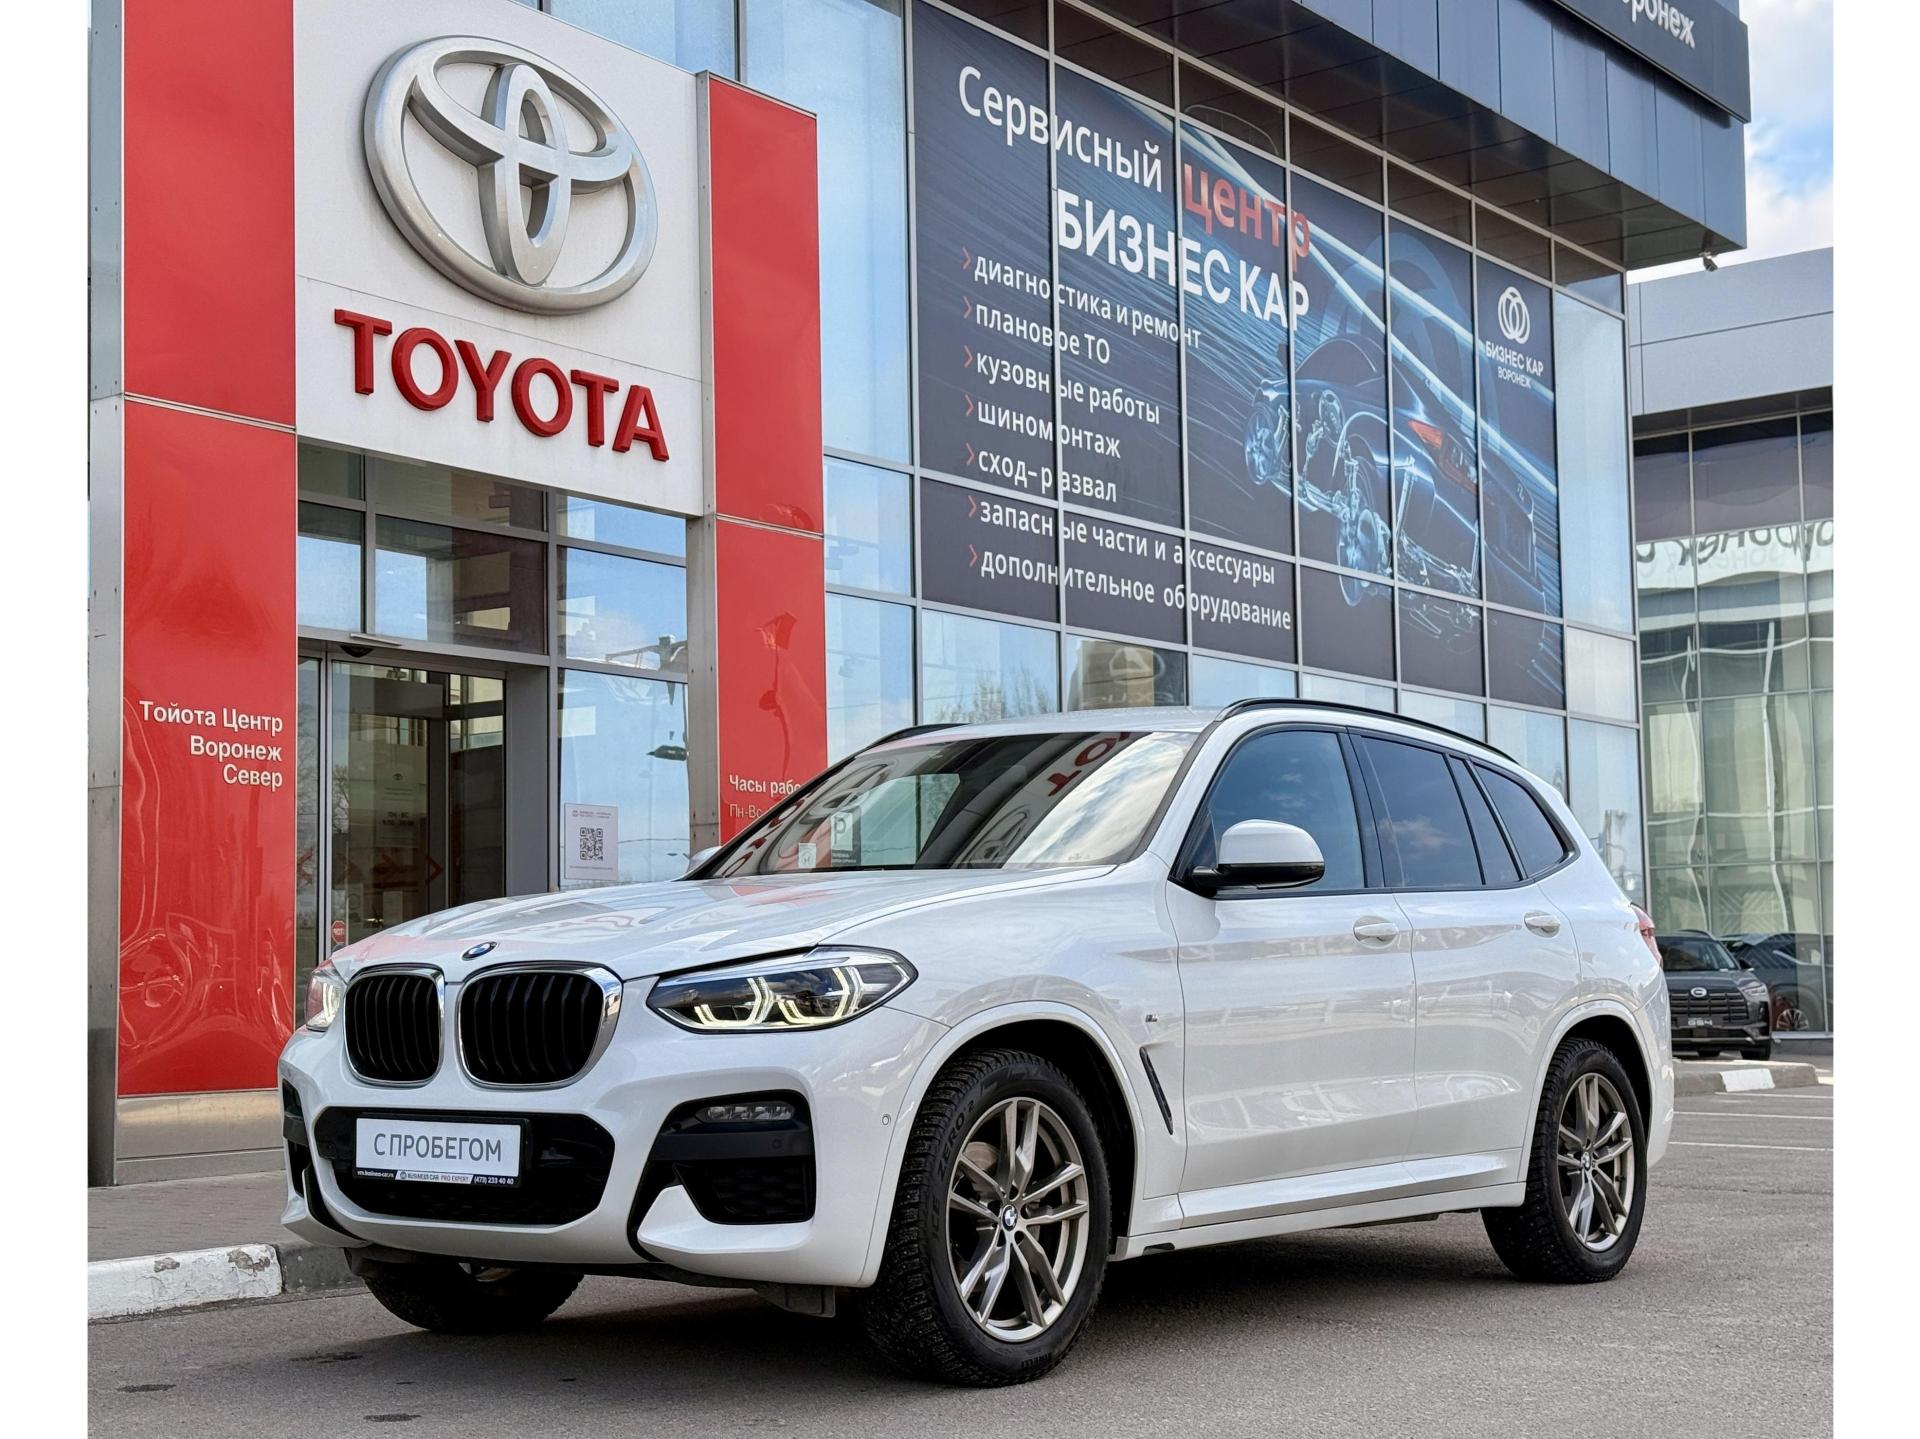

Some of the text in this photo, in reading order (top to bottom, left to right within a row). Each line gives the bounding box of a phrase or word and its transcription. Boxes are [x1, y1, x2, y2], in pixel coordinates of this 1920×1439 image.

[1622, 0, 1696, 49] ронеж
[959, 65, 1310, 273] Сервисный центр
[1057, 188, 1310, 332] БИЗНЕС КАР
[974, 255, 1202, 349] диагностика и ремонт
[975, 303, 1111, 365] плановое ТО
[1485, 340, 1544, 377] БИЗНЕС КАР
[334, 308, 670, 463] TOYOTA
[976, 352, 1161, 425] кузовные работы
[1497, 366, 1532, 389] ВОРОНЕЖ
[977, 400, 1121, 459] шиномонтаж
[980, 500, 1275, 588] запасные части и аксессуары
[980, 550, 1292, 630] дополнительное оборудование
[139, 700, 283, 737] Тойота Центр
[190, 735, 283, 762] Воронеж
[223, 763, 283, 792] Север
[729, 774, 767, 793] Часы
[373, 1133, 502, 1163] С ПРОБЕГОМ
